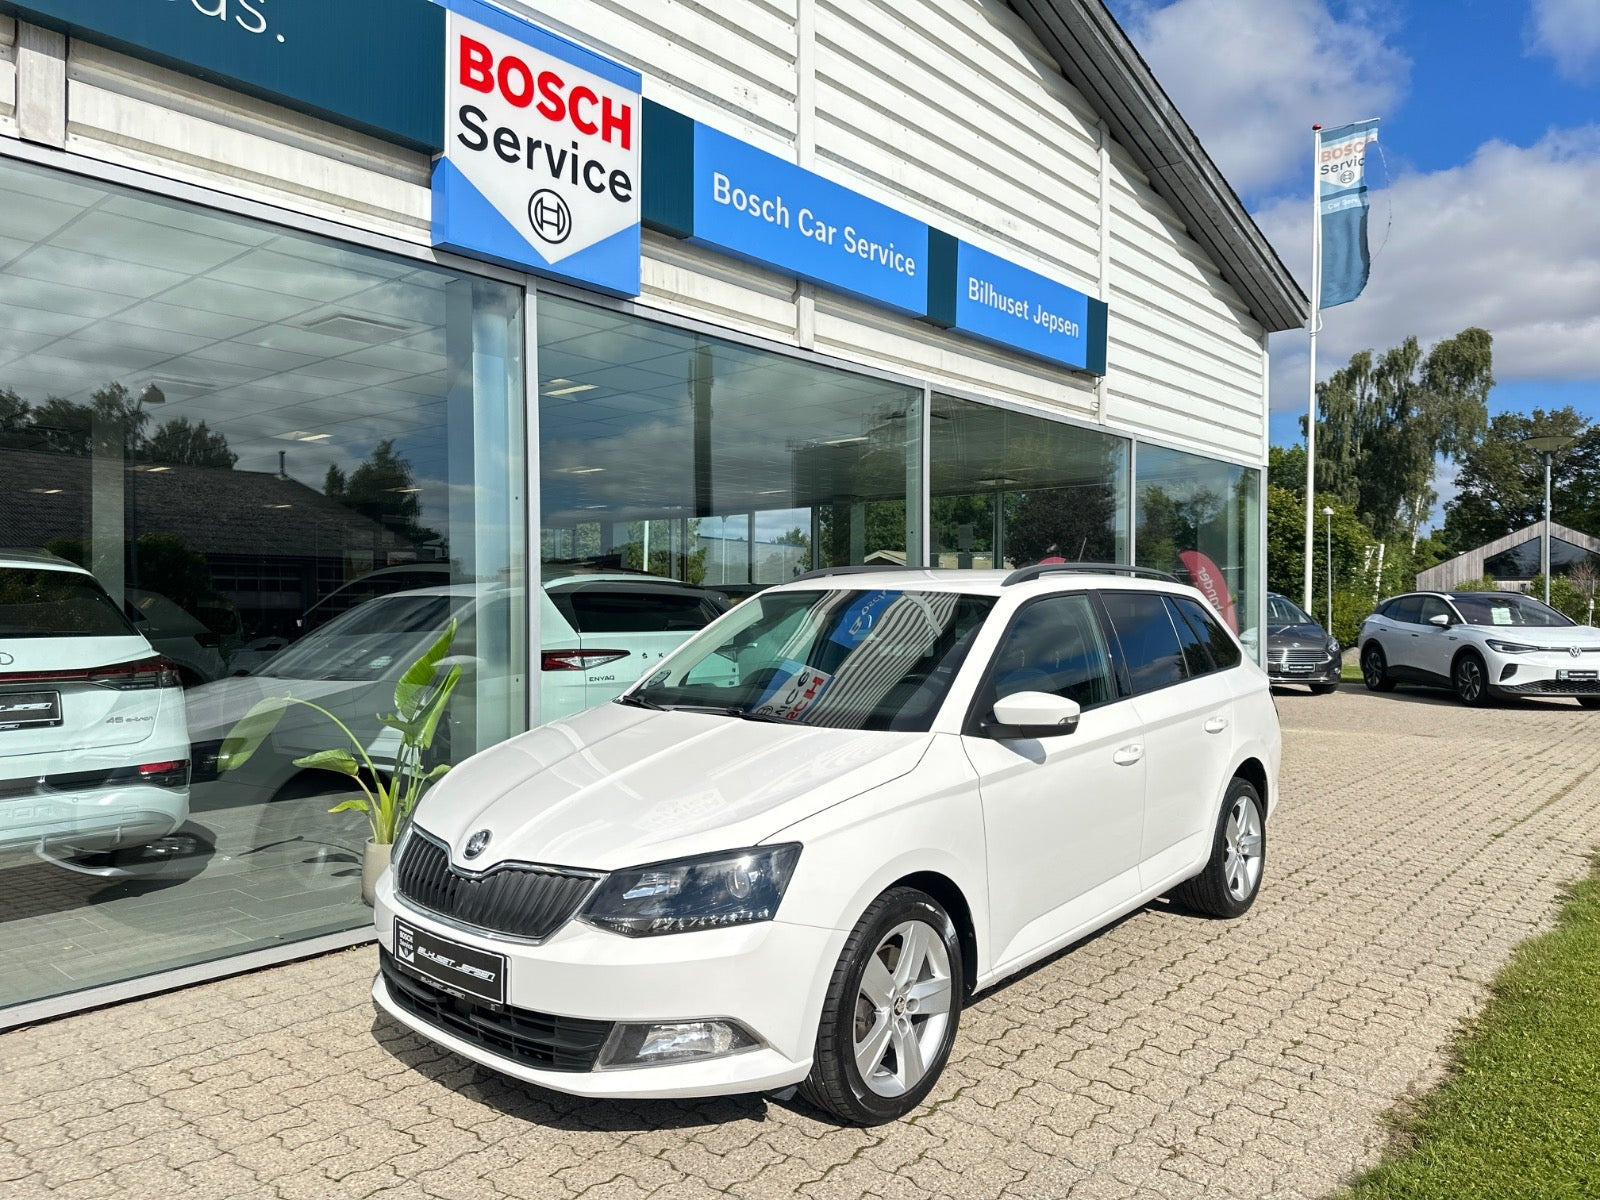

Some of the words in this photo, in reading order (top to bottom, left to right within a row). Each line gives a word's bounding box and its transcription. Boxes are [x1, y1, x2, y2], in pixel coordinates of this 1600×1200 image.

[458, 34, 632, 151] BOSCH
[457, 104, 633, 204] Service
[1320, 156, 1365, 175] Servic
[1321, 140, 1366, 163] BOSC
[713, 171, 790, 230] Bosch
[798, 208, 836, 247] Car
[843, 225, 916, 277] Service
[968, 276, 1030, 321] Bilhuset
[1033, 303, 1080, 340] Jepsen
[588, 674, 616, 682] ENYAQ
[106, 716, 123, 724] 45
